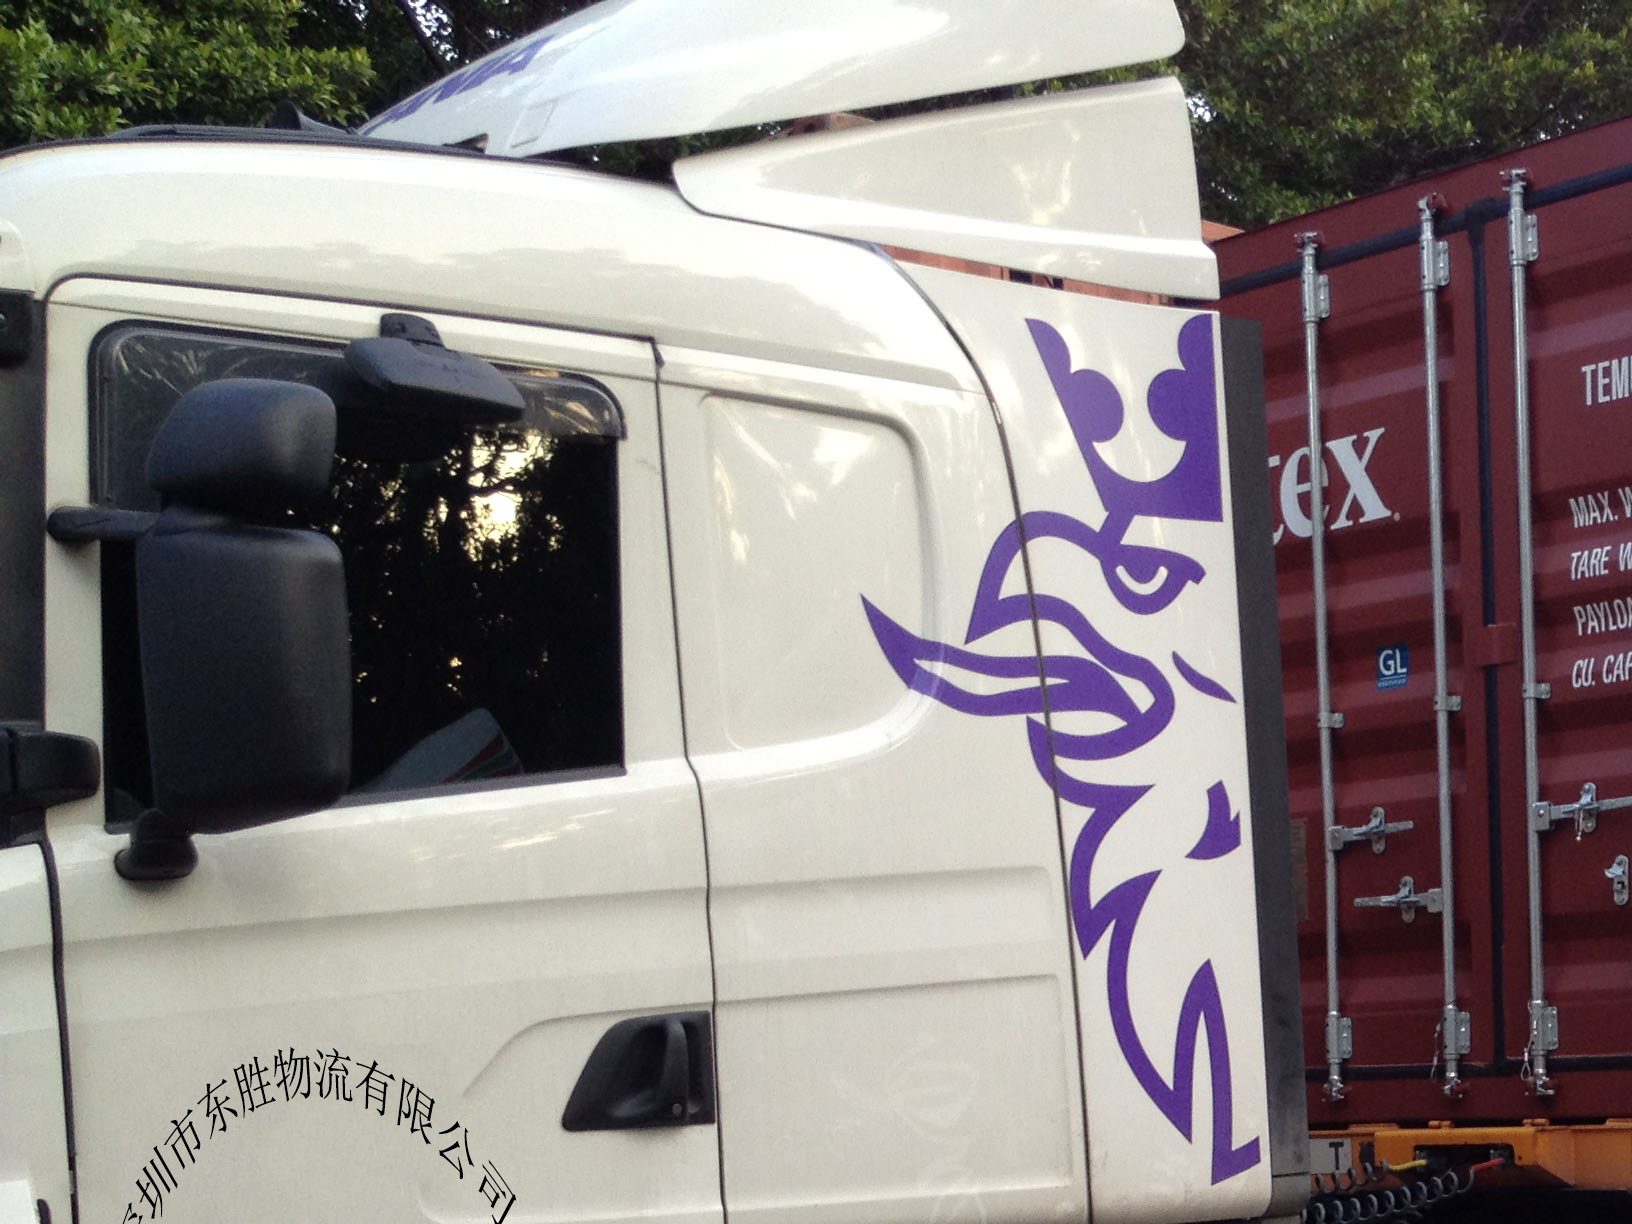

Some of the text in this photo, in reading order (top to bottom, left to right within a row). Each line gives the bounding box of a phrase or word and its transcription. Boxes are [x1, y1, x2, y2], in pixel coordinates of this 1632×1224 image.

[1569, 490, 1618, 529] MAX.
[1571, 545, 1611, 581] TARE
[1379, 648, 1408, 676] GL
[1572, 658, 1596, 688] CU.
